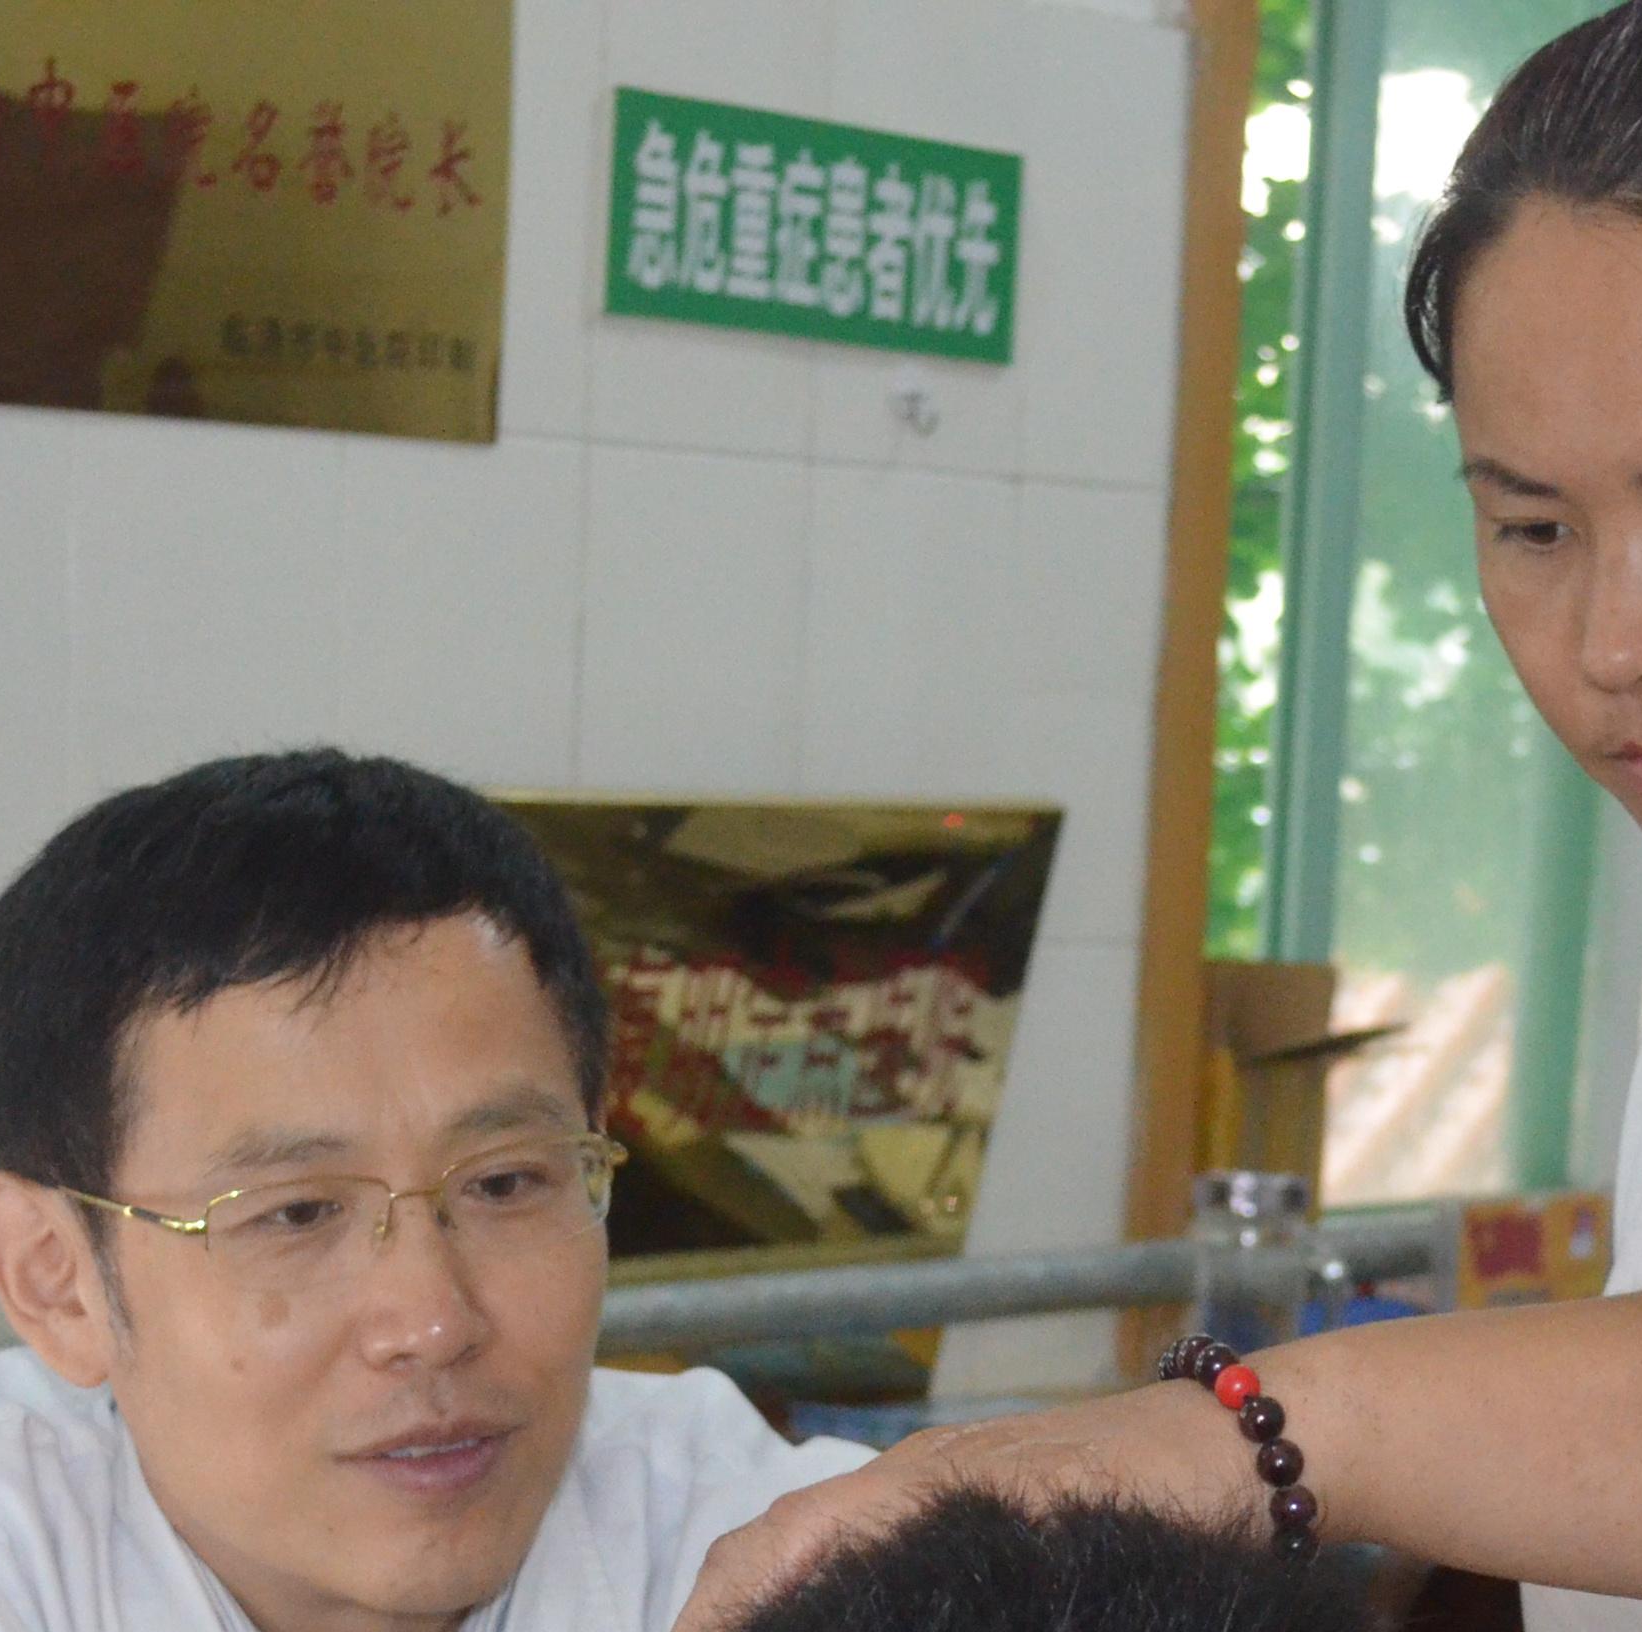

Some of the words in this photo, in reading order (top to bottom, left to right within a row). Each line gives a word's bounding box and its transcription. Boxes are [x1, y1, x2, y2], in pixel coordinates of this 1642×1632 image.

[625, 117, 1002, 337] 急危重症患者优先
